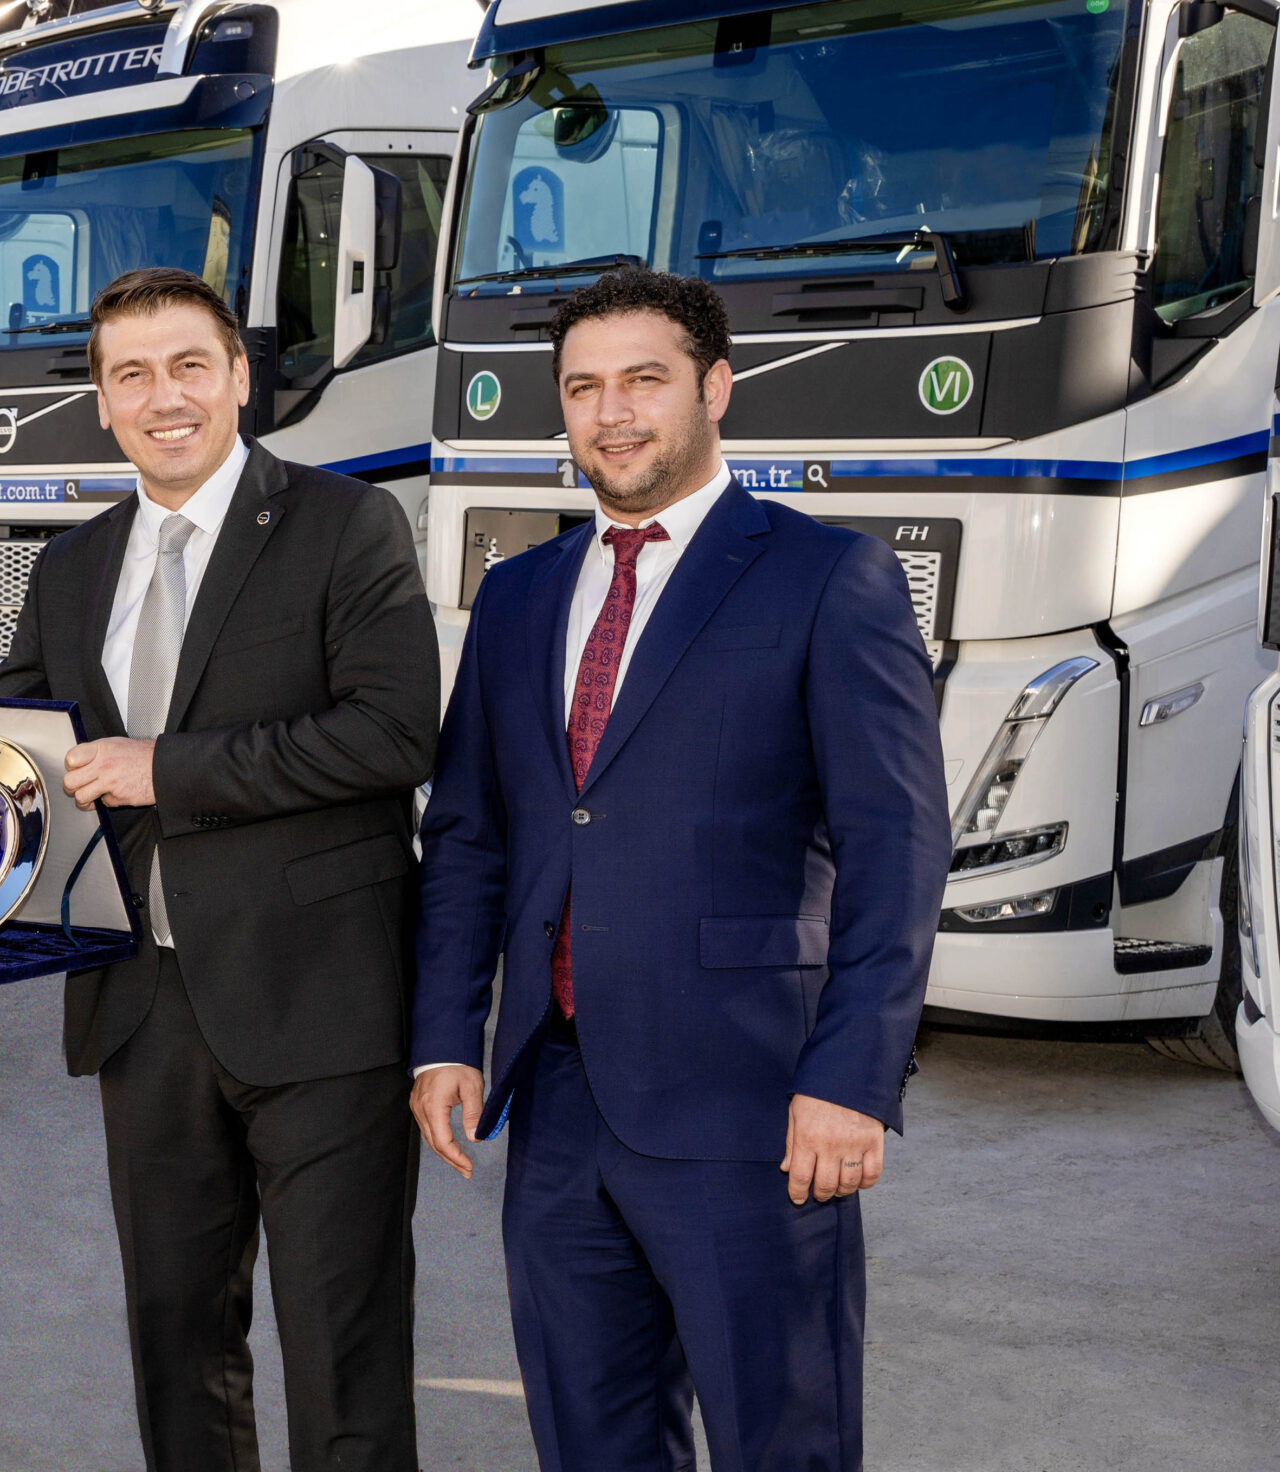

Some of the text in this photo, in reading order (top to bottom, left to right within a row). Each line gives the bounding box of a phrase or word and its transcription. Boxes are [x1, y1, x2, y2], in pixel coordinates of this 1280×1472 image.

[477, 381, 491, 411] L
[930, 371, 962, 402] VI
[895, 526, 929, 541] FH
